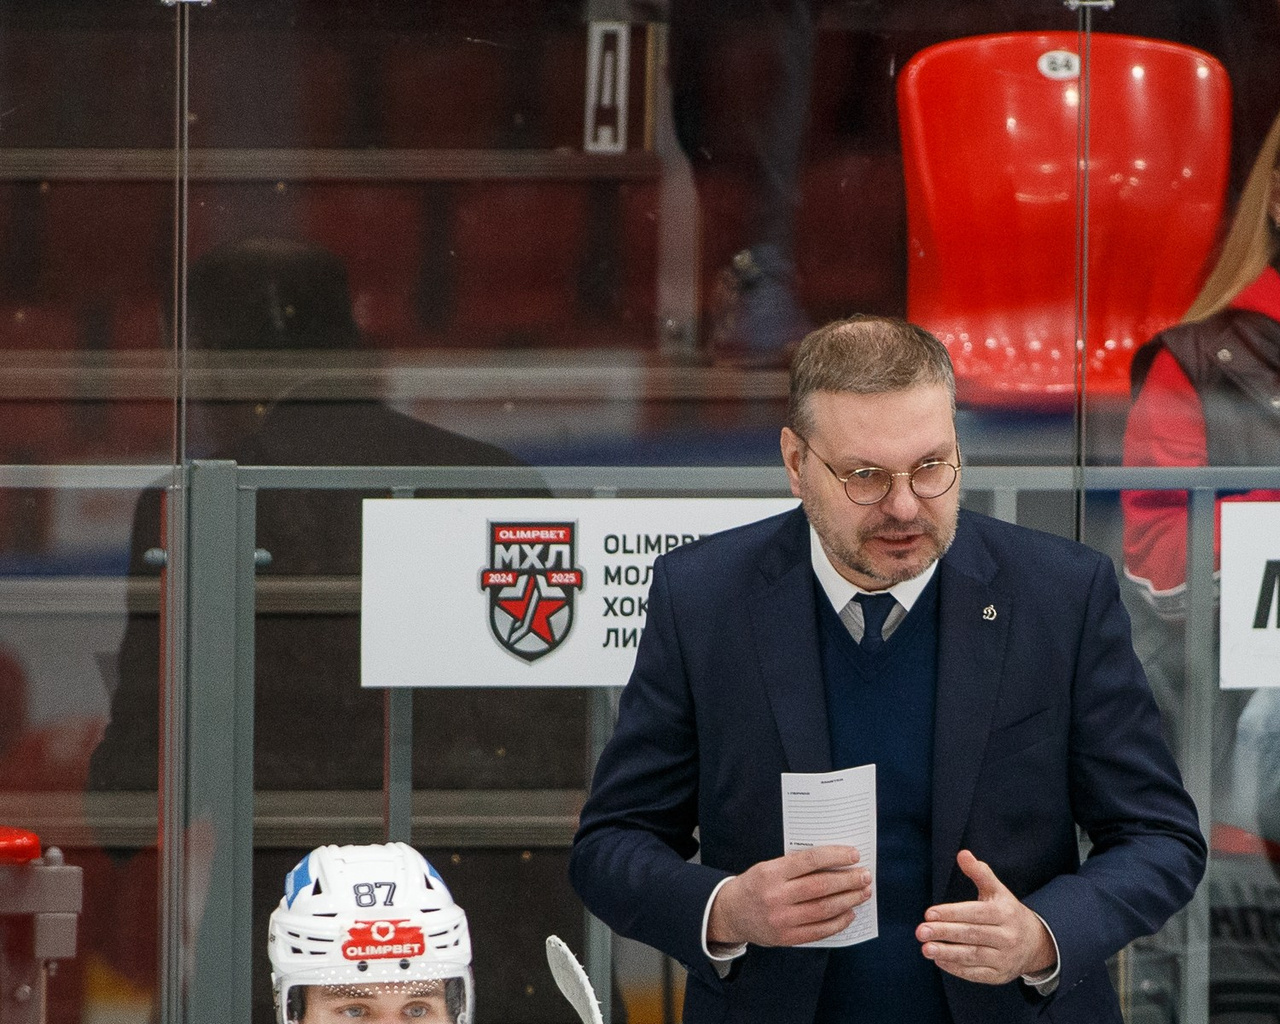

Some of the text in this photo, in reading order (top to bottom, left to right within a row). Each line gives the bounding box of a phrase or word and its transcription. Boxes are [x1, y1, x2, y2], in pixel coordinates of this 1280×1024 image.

[499, 530, 566, 539] OLIMPBET
[494, 544, 570, 569] МХЛ
[488, 573, 576, 583] 2024 2025
[353, 881, 397, 907] 87
[346, 943, 421, 957] OLIMPBET
